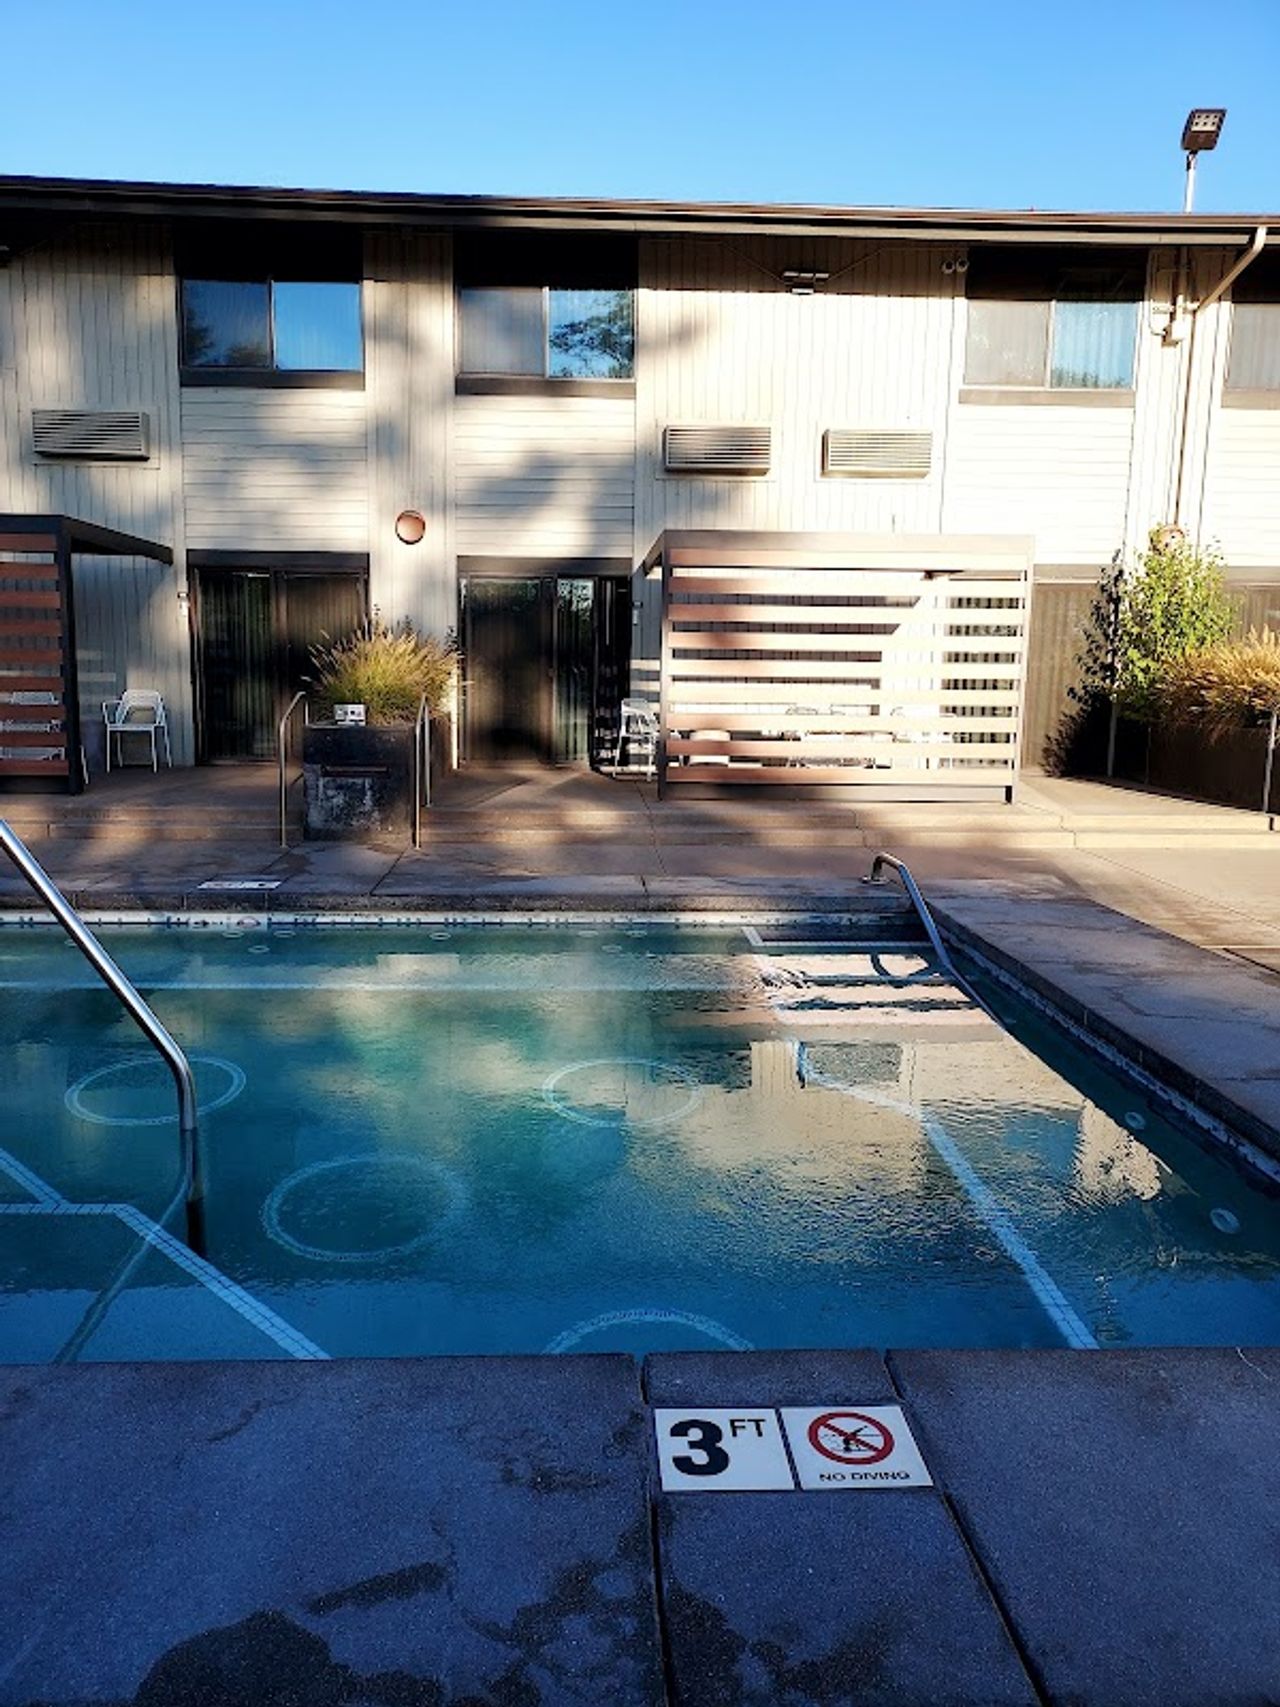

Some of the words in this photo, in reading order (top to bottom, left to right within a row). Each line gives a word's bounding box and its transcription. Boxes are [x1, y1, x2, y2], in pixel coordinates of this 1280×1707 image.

[669, 1419, 730, 1476] 3
[729, 1418, 767, 1437] FT
[819, 1472, 846, 1482] NO
[851, 1470, 910, 1481] DIVING
